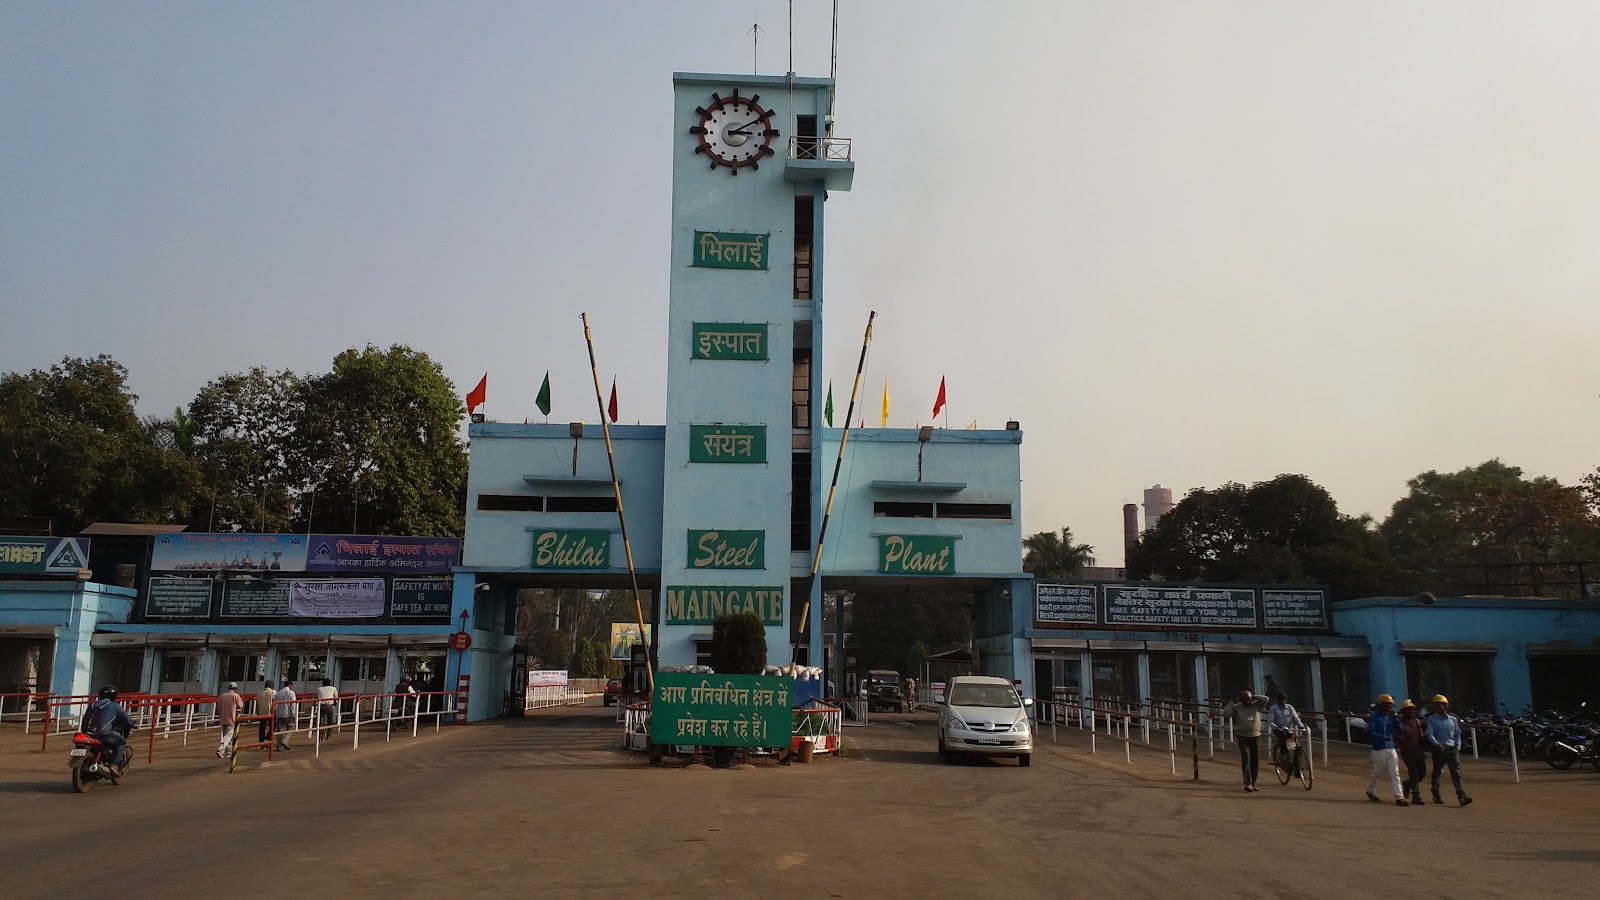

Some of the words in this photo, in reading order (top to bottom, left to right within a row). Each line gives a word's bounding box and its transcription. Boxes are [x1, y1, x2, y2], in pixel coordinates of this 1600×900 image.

[700, 233, 763, 268] भिलाई
[699, 332, 762, 359] इस्पात
[703, 430, 754, 456] संयंत्र
[336, 540, 379, 556] भिलाई
[383, 543, 422, 556] इस्पात
[536, 531, 607, 566] Bhilai
[694, 531, 758, 566] Steel
[885, 535, 950, 572] Plant
[337, 558, 362, 566] आपका
[394, 582, 422, 591] SAFETY
[422, 582, 432, 591] AT
[417, 592, 425, 601] IS
[1119, 588, 1159, 599] सुरक्षित
[1164, 590, 1191, 600] कार्य
[1195, 590, 1232, 600] प्रणाली
[392, 603, 409, 612] SAFE
[410, 603, 422, 613] TEA
[423, 603, 433, 612] AT
[433, 603, 450, 612] HOME
[667, 590, 782, 621] MAINGATE
[1109, 606, 1128, 614] MAKE
[1221, 609, 1238, 617] JOB
[1112, 614, 1144, 622] PRACTICE
[660, 687, 687, 704] आप
[691, 680, 750, 706] प्रतिबंधित
[752, 682, 774, 710] क्षेत्र
[777, 683, 788, 707] में
[677, 711, 707, 739] प्रवेश
[711, 719, 729, 738] कर
[733, 713, 749, 742] रहे
[752, 712, 767, 742] हैं।
